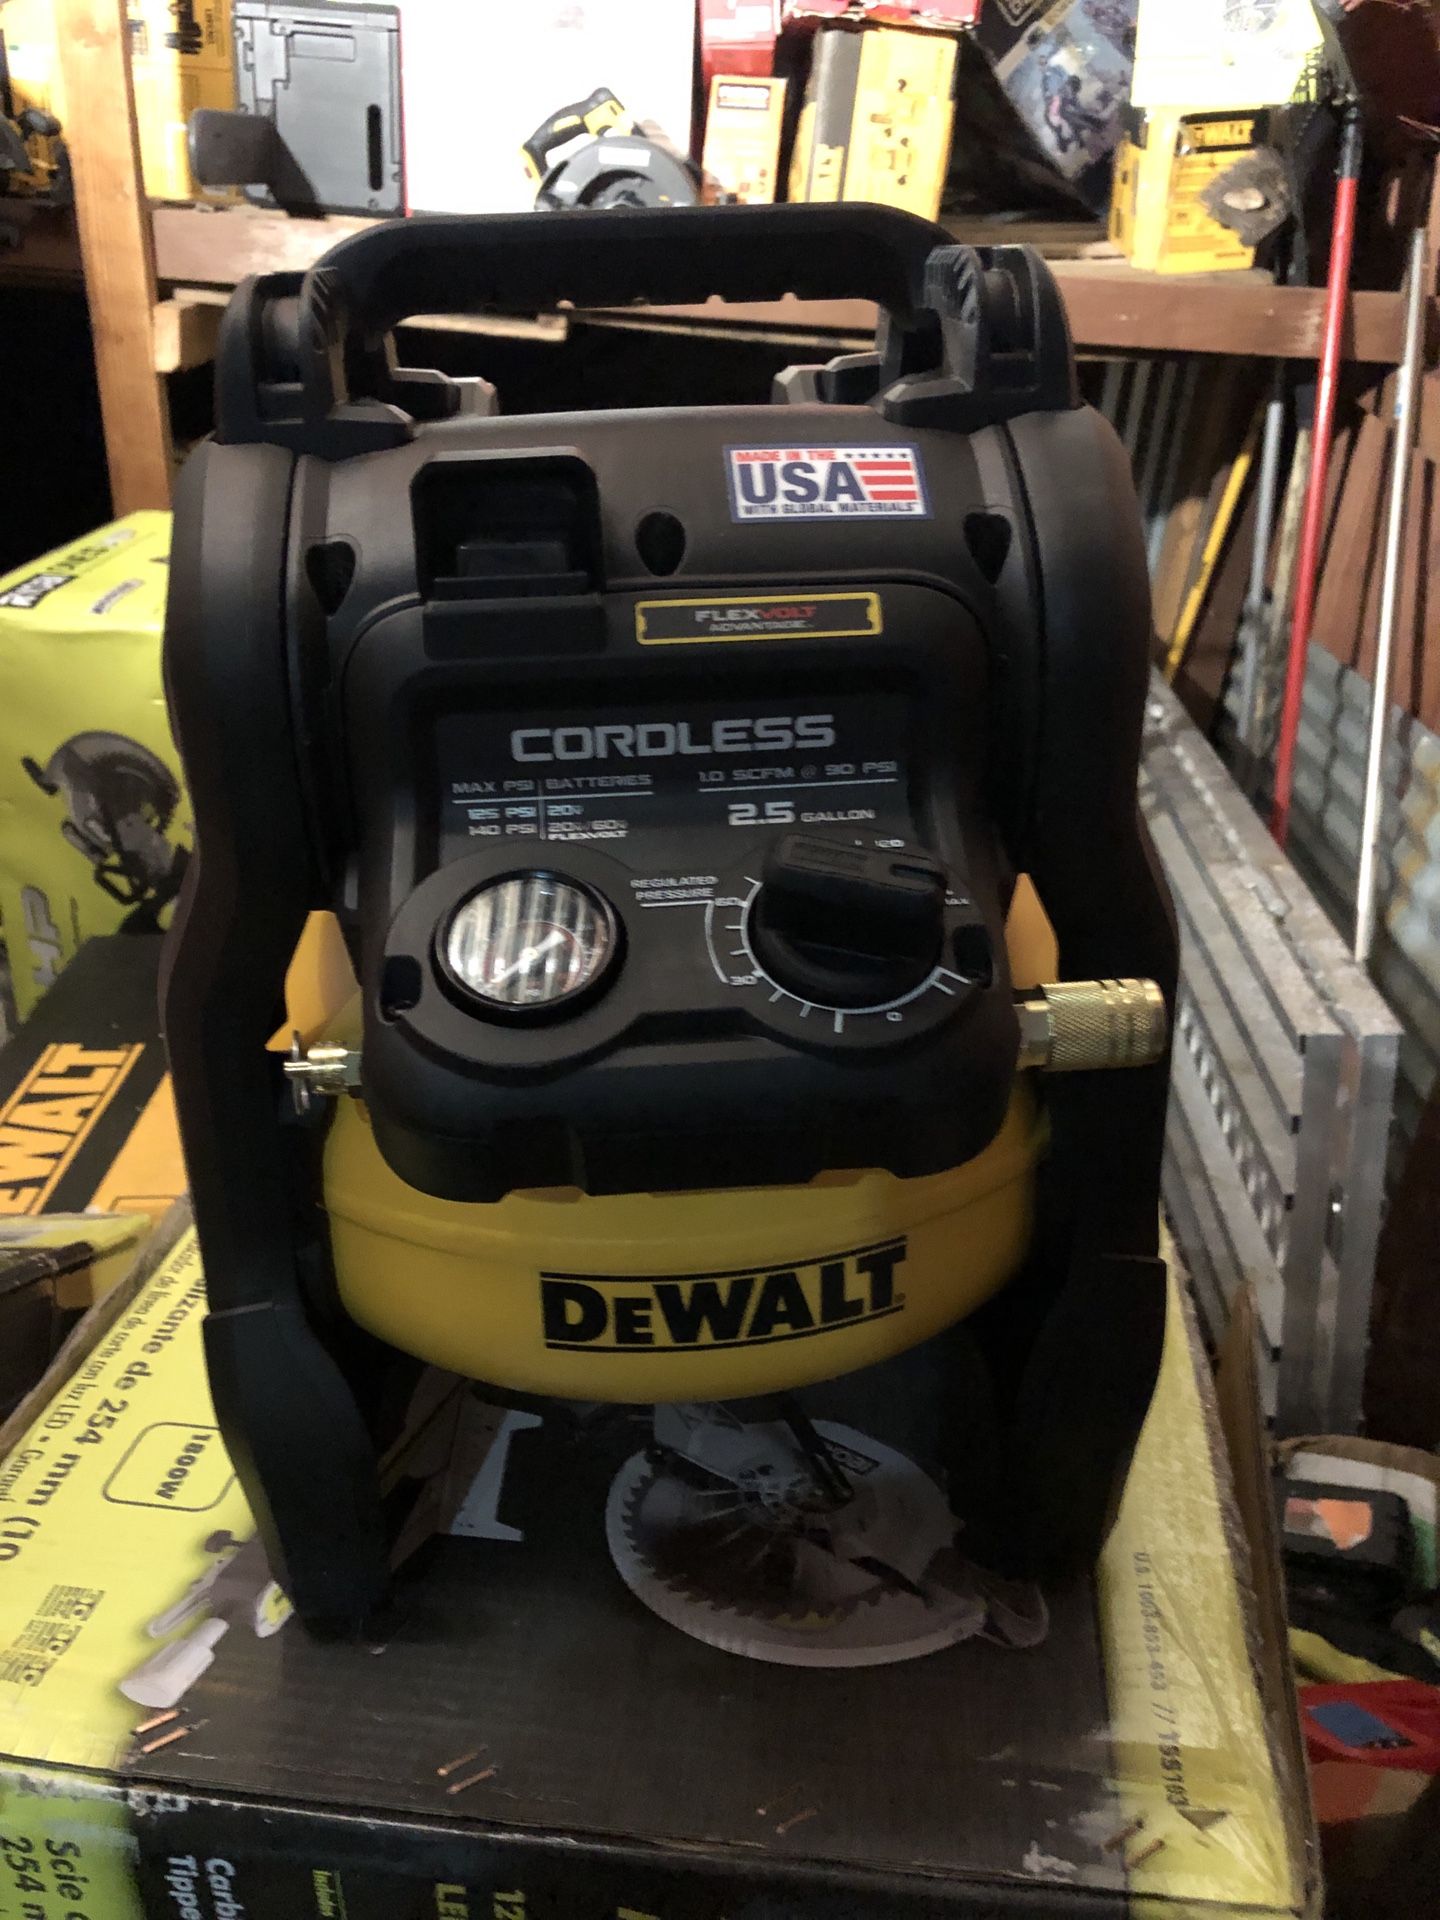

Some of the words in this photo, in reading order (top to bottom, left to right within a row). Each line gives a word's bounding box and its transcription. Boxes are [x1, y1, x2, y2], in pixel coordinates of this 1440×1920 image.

[735, 451, 780, 462] MADE
[786, 450, 801, 461] IN
[807, 450, 837, 460] THE
[738, 462, 867, 504] USA
[782, 503, 833, 514] GLOBAL
[838, 501, 915, 513] MATERIALS
[694, 606, 817, 622] FLEXVOLT
[510, 714, 836, 762] CORDLESS
[732, 767, 795, 781] SCFM
[862, 761, 898, 774] PSI
[452, 781, 497, 794] MAX
[503, 779, 535, 791] PSI
[545, 774, 653, 790] BATTERIES
[505, 806, 538, 818] PSI
[728, 801, 796, 826] 2.5
[800, 809, 876, 822] GALLON
[505, 823, 538, 834] PSI
[630, 875, 719, 889] REGULATED
[635, 888, 715, 900] PRESSURE
[114, 1361, 153, 1390] de
[66, 1382, 99, 1400] luz
[44, 1404, 80, 1430] LED
[74, 1398, 129, 1445] 254
[155, 1434, 213, 1500] 1800W
[27, 1453, 81, 1506] mm
[0, 1836, 47, 1893] 254
[46, 1838, 89, 1901] Scie
